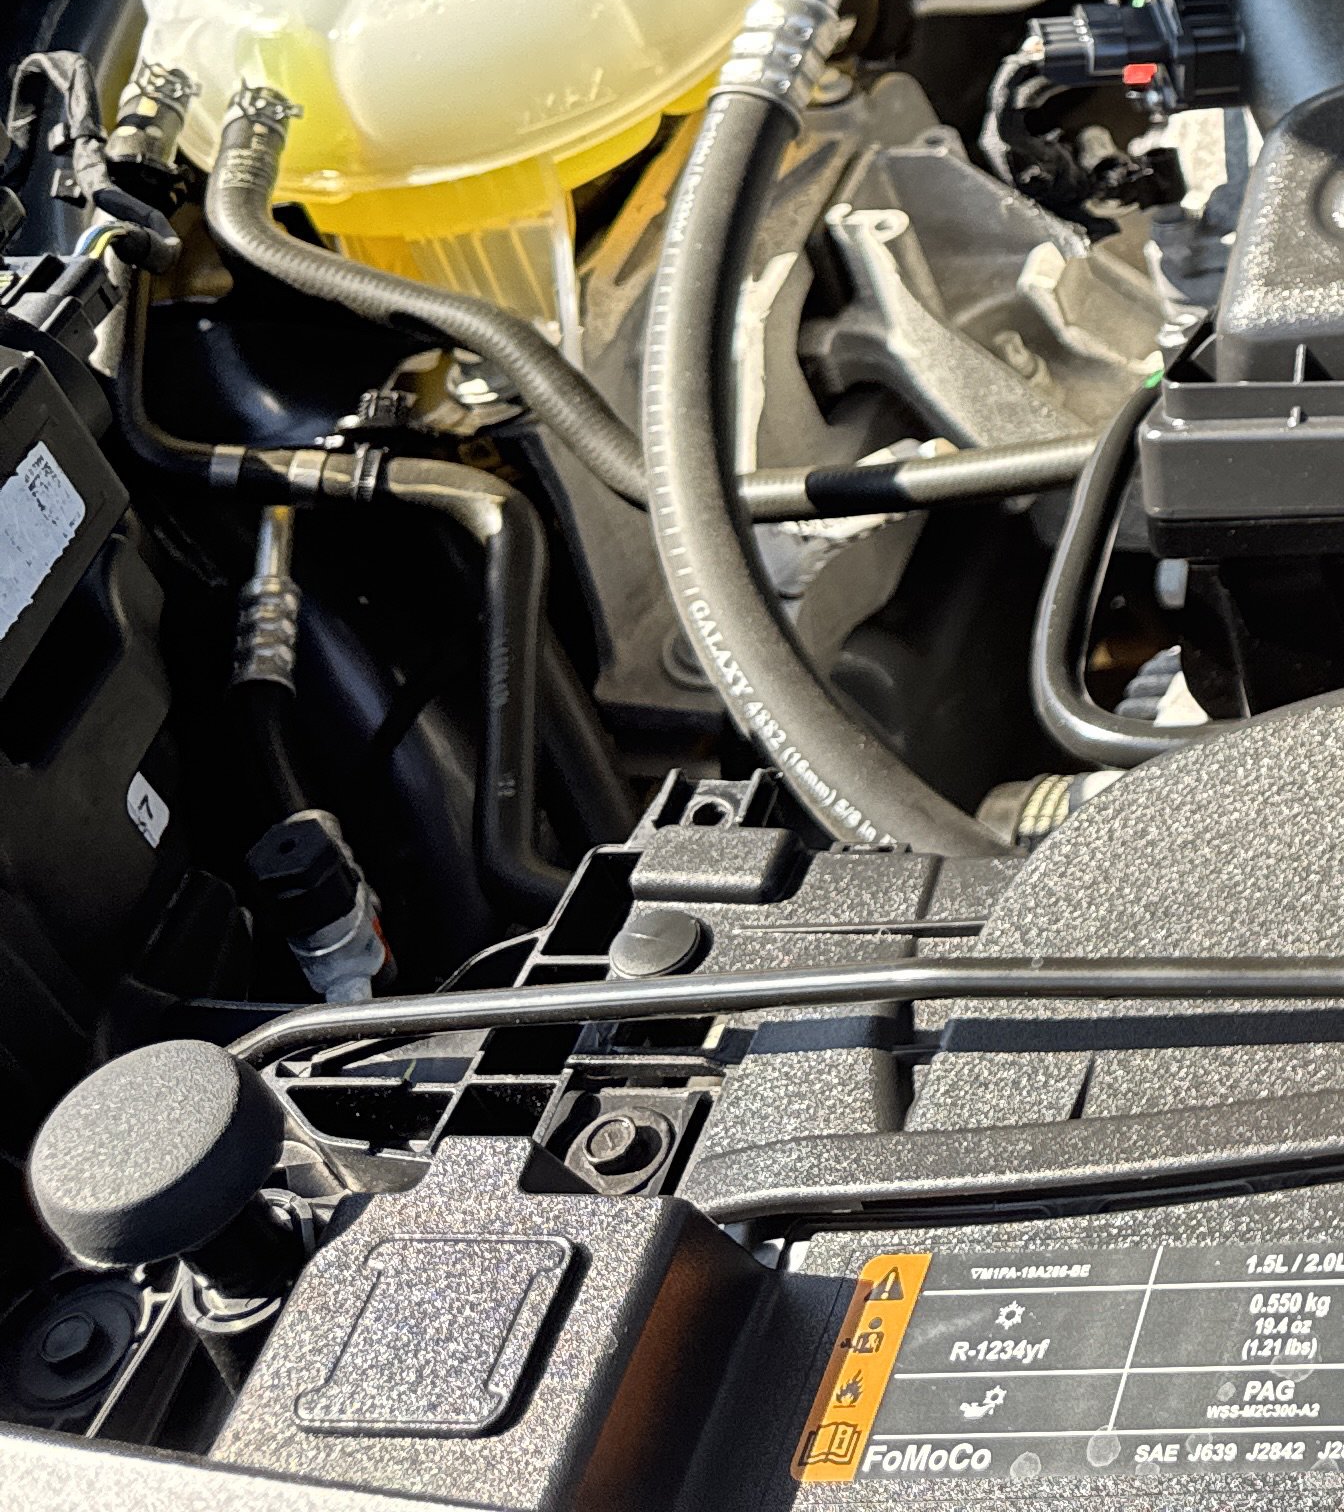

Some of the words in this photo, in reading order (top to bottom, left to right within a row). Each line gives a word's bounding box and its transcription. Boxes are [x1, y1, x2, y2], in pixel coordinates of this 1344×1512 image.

[689, 599, 754, 697] GALAXY
[744, 701, 787, 752] 4882
[1246, 1253, 1288, 1274] 1.5L
[1290, 1253, 1304, 1274] /
[1250, 1292, 1302, 1314] 0.550
[1304, 1292, 1331, 1318] kg
[1254, 1316, 1289, 1334] 19.4
[1290, 1319, 1312, 1334] oz
[950, 1338, 1050, 1364] R-1234yf
[1242, 1338, 1280, 1361] (1.21
[1284, 1338, 1318, 1359] lbs)
[1243, 1380, 1296, 1402] PAG
[862, 1443, 992, 1473] FoMoCo
[1134, 1442, 1180, 1463] SAE
[1187, 1442, 1238, 1462] J639
[1246, 1441, 1306, 1461] J2842
